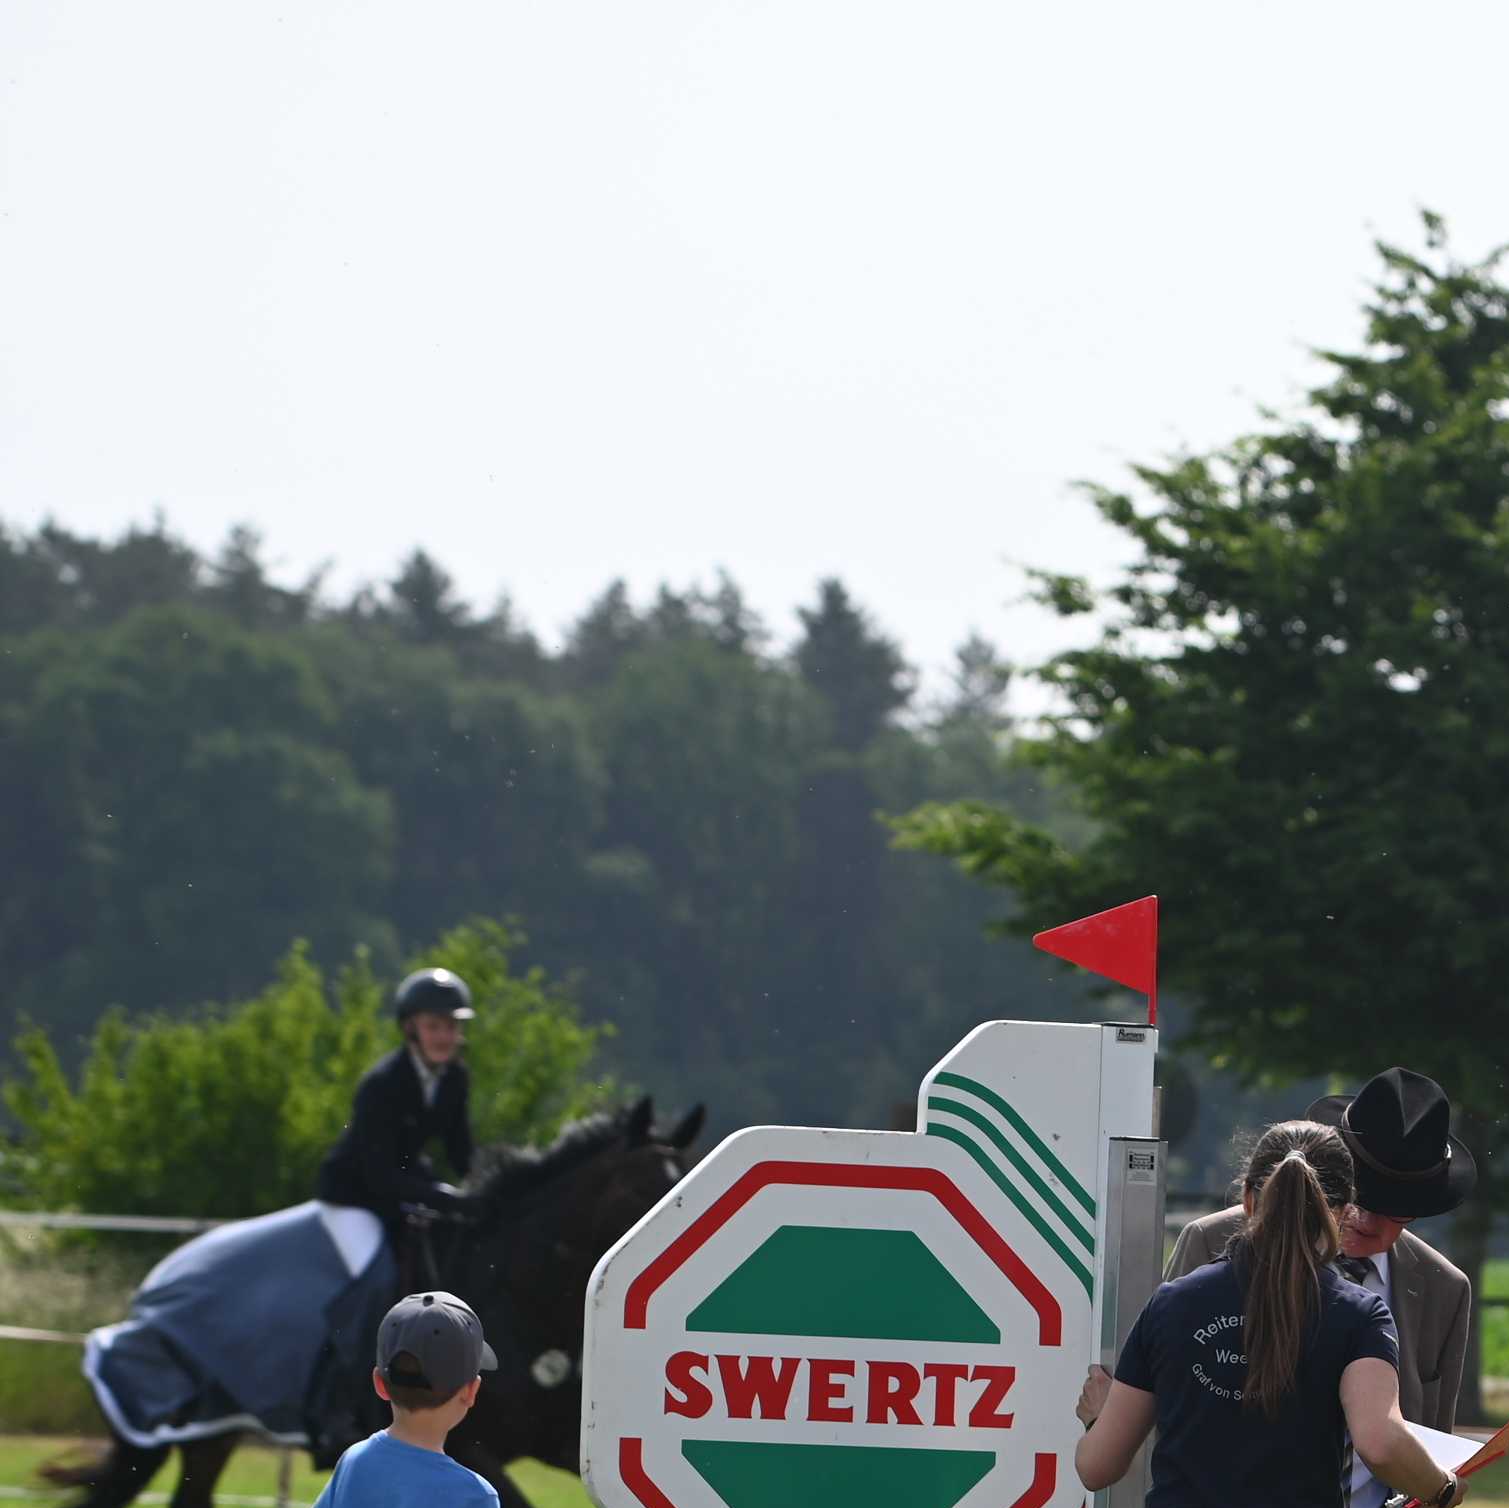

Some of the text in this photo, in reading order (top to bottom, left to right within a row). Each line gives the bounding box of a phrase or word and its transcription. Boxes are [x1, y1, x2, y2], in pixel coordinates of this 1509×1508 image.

[663, 1350, 1016, 1429] SWERTZ
[1192, 1363, 1212, 1386] Graf
[1209, 1383, 1230, 1399] von
